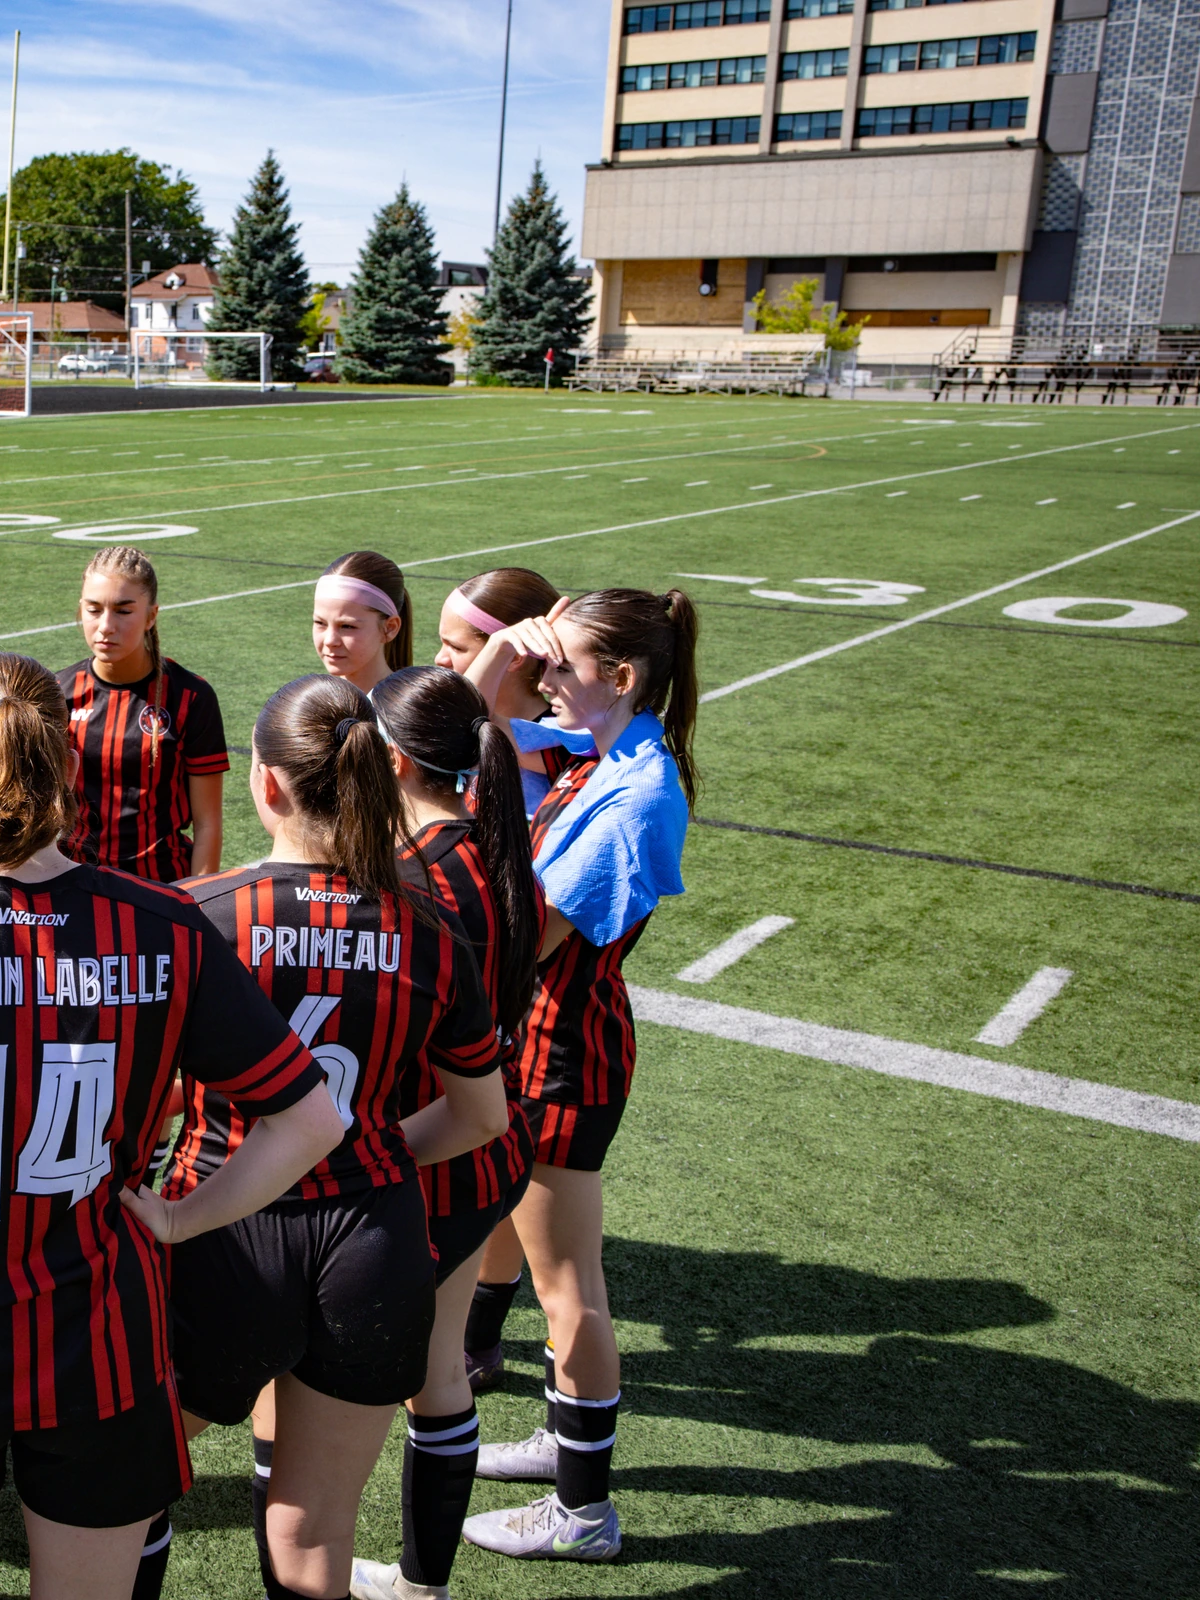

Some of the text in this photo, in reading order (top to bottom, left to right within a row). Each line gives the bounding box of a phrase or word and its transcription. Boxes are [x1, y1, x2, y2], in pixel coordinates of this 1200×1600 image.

[295, 887, 362, 905] VNATION
[251, 925, 401, 973] PRIMEAU
[36, 954, 171, 1006] LABELLE
[288, 995, 360, 1132] 6
